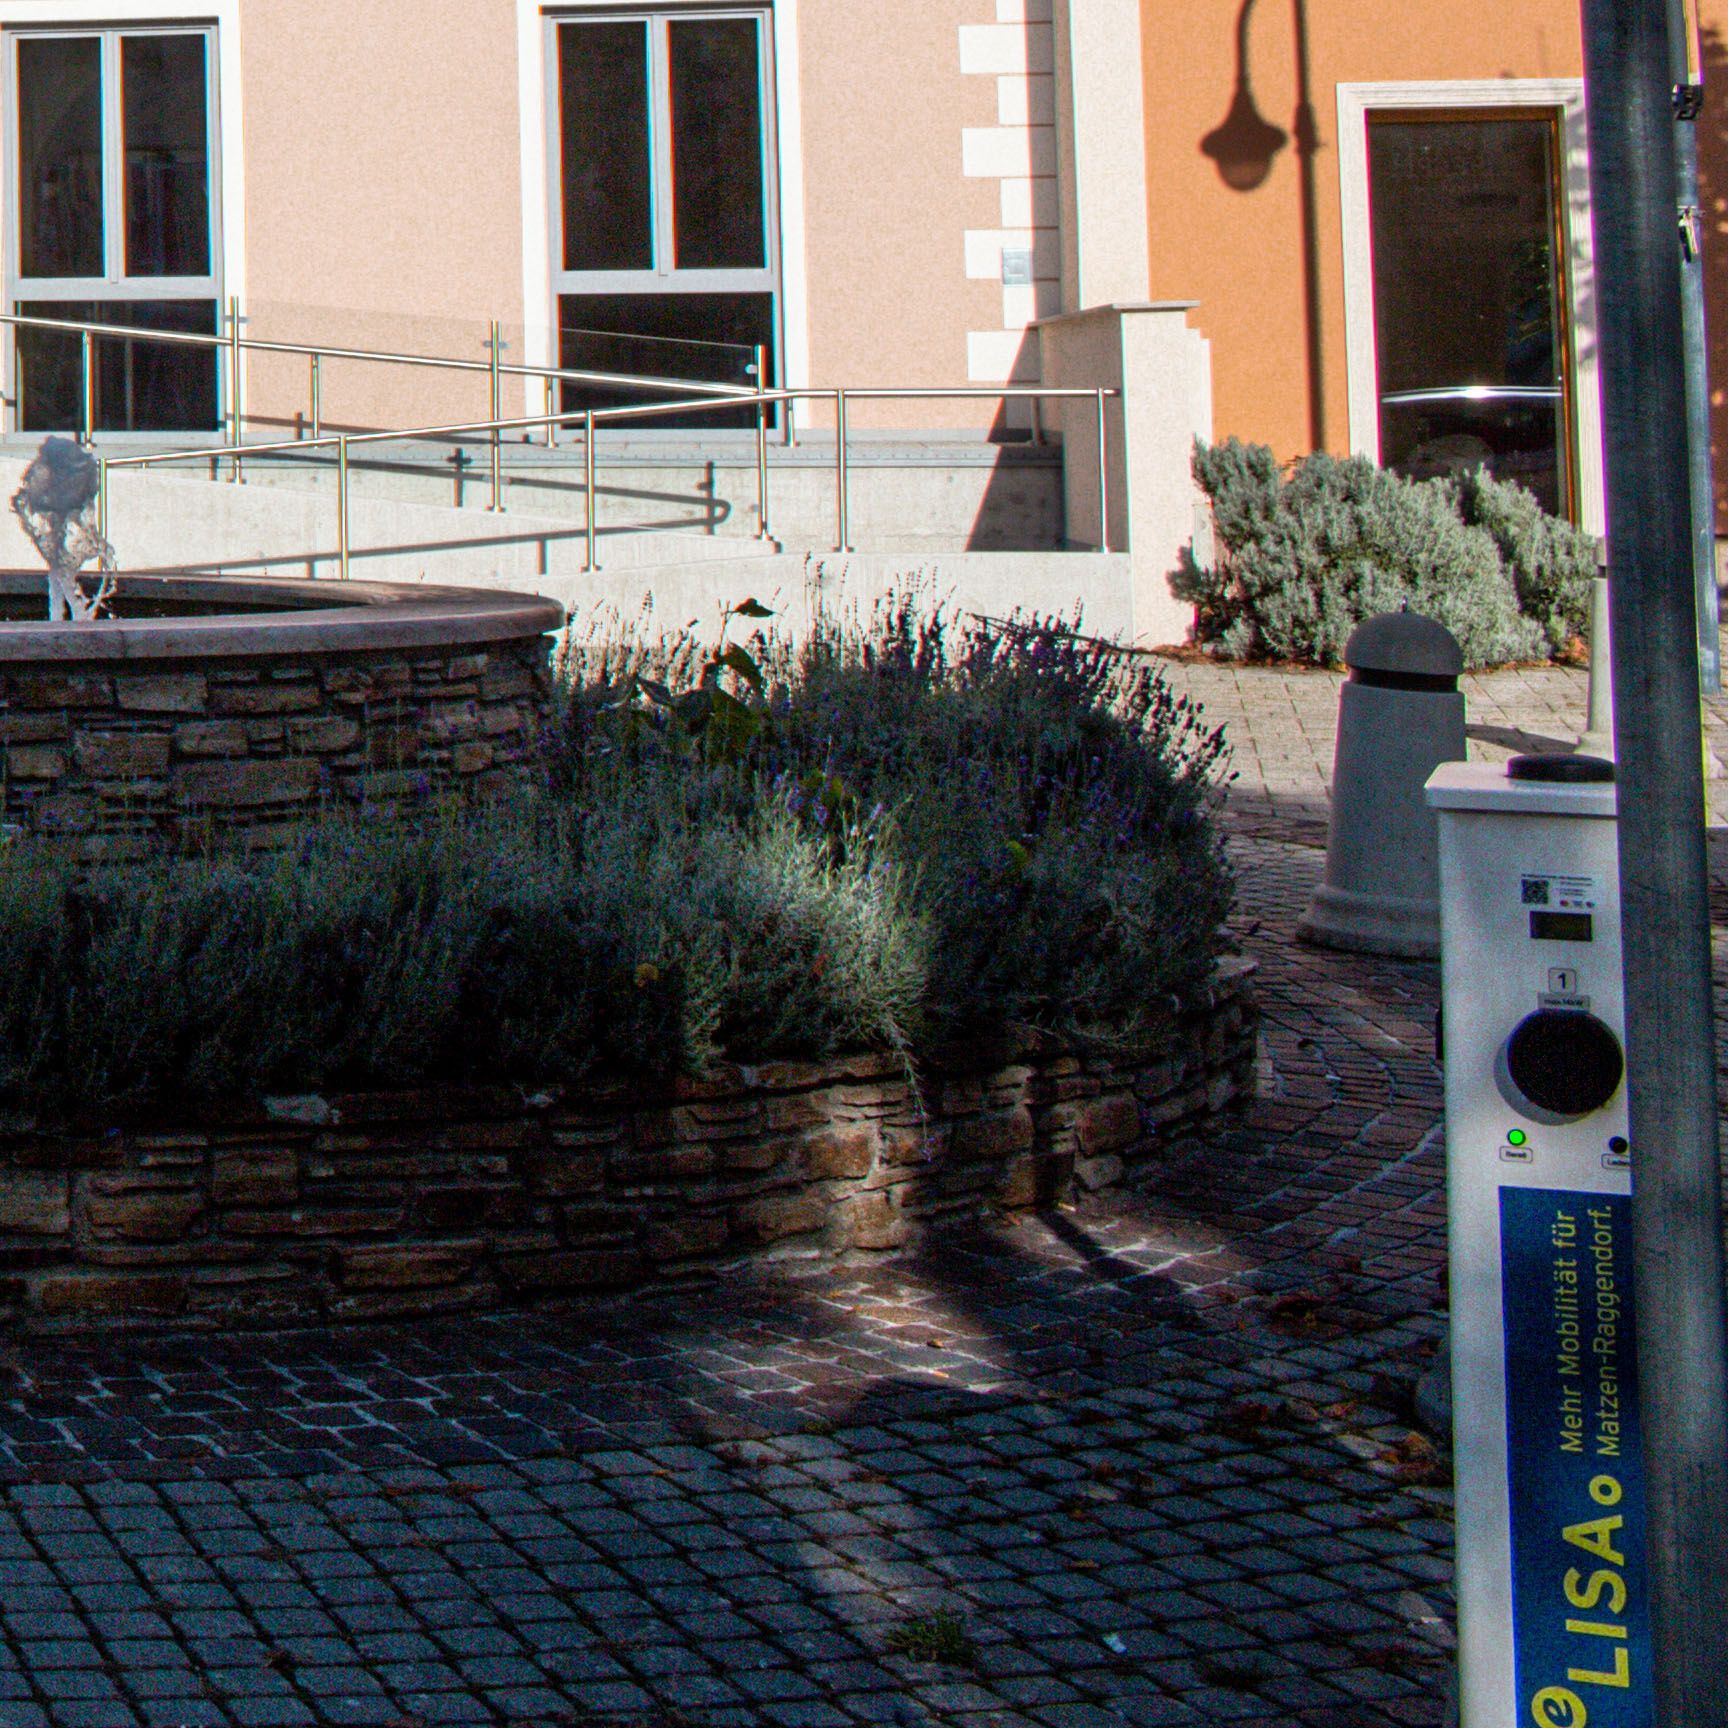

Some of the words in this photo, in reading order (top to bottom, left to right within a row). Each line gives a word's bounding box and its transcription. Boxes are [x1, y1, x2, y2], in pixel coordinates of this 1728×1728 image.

[1557, 971, 1567, 990] 1
[1552, 1210, 1577, 1248] für
[1553, 1257, 1581, 1376] Mobilität
[1587, 1204, 1622, 1457] Matzen-Raggendorf.
[1558, 1385, 1584, 1454] Mehr
